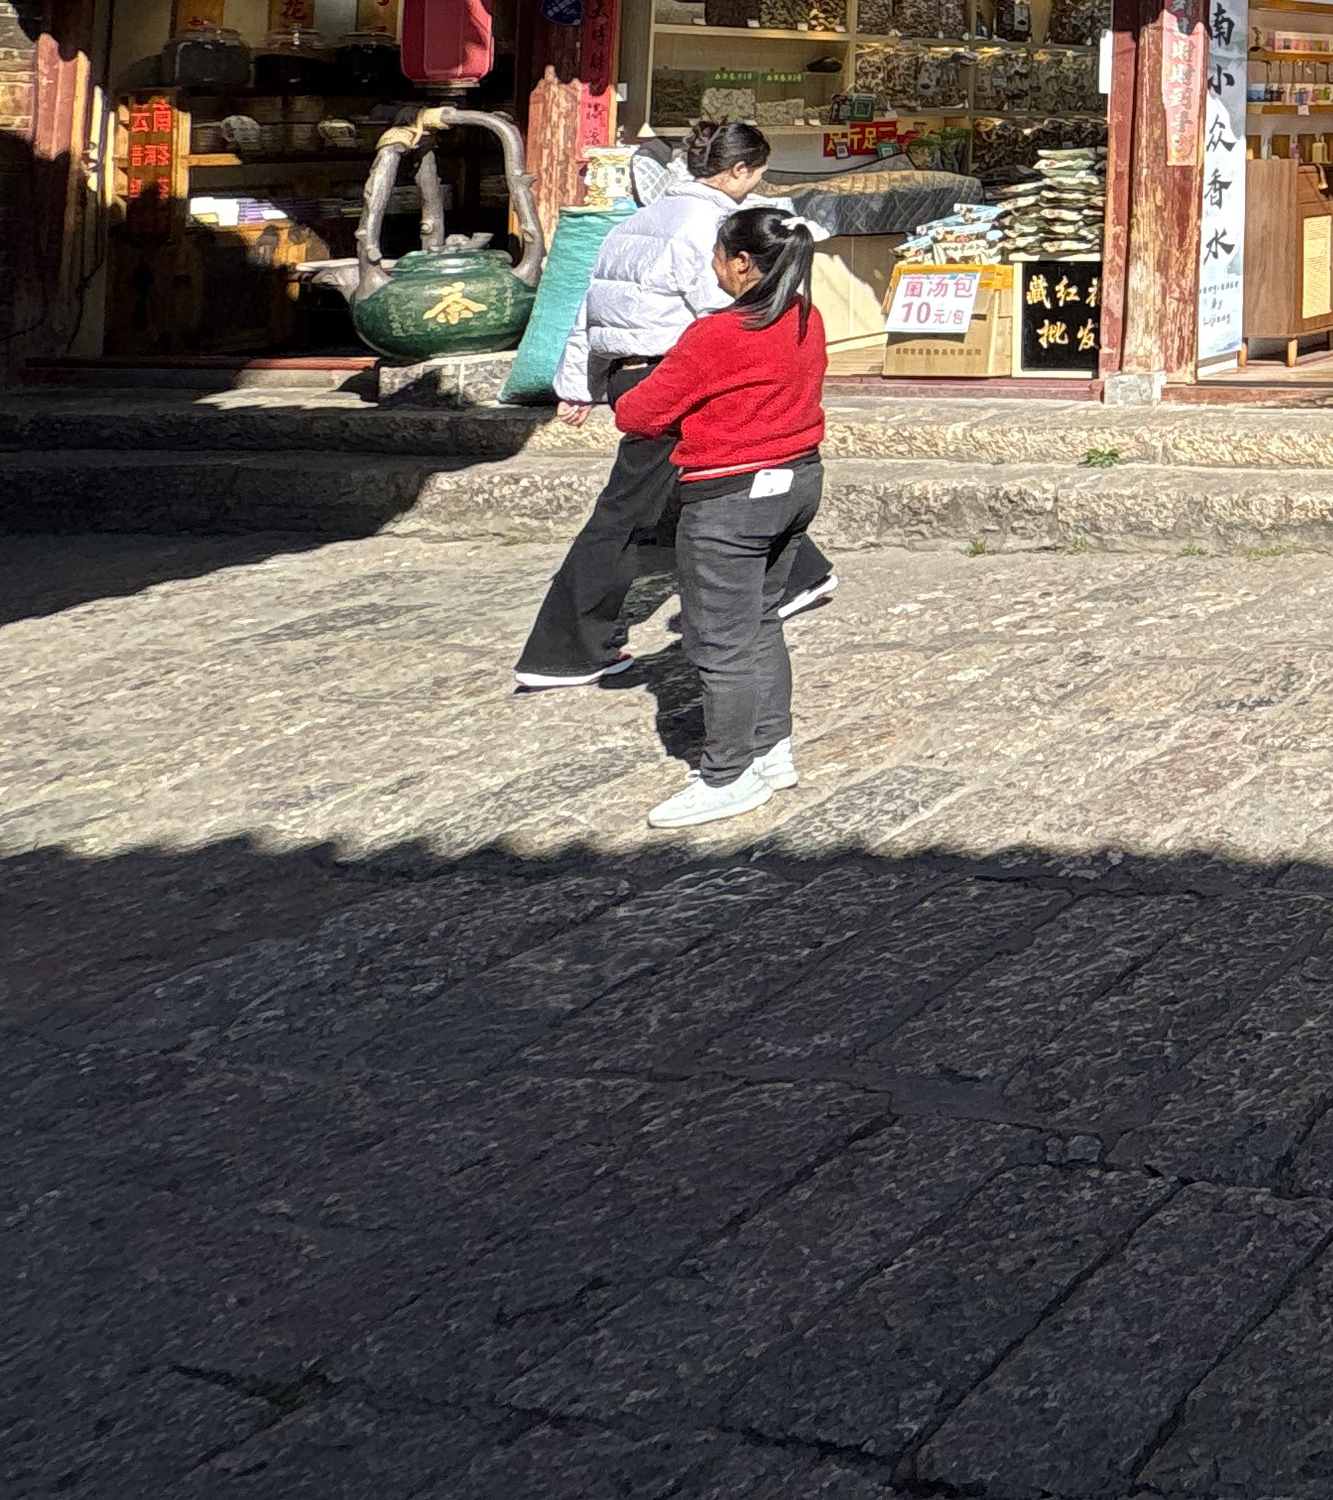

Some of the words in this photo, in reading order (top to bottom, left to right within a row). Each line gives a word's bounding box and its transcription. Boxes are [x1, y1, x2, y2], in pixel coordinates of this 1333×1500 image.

[903, 276, 974, 299] 菌汤包
[422, 281, 488, 325] 茶
[901, 301, 965, 325] 10元/包
[1036, 318, 1099, 352] 批发
